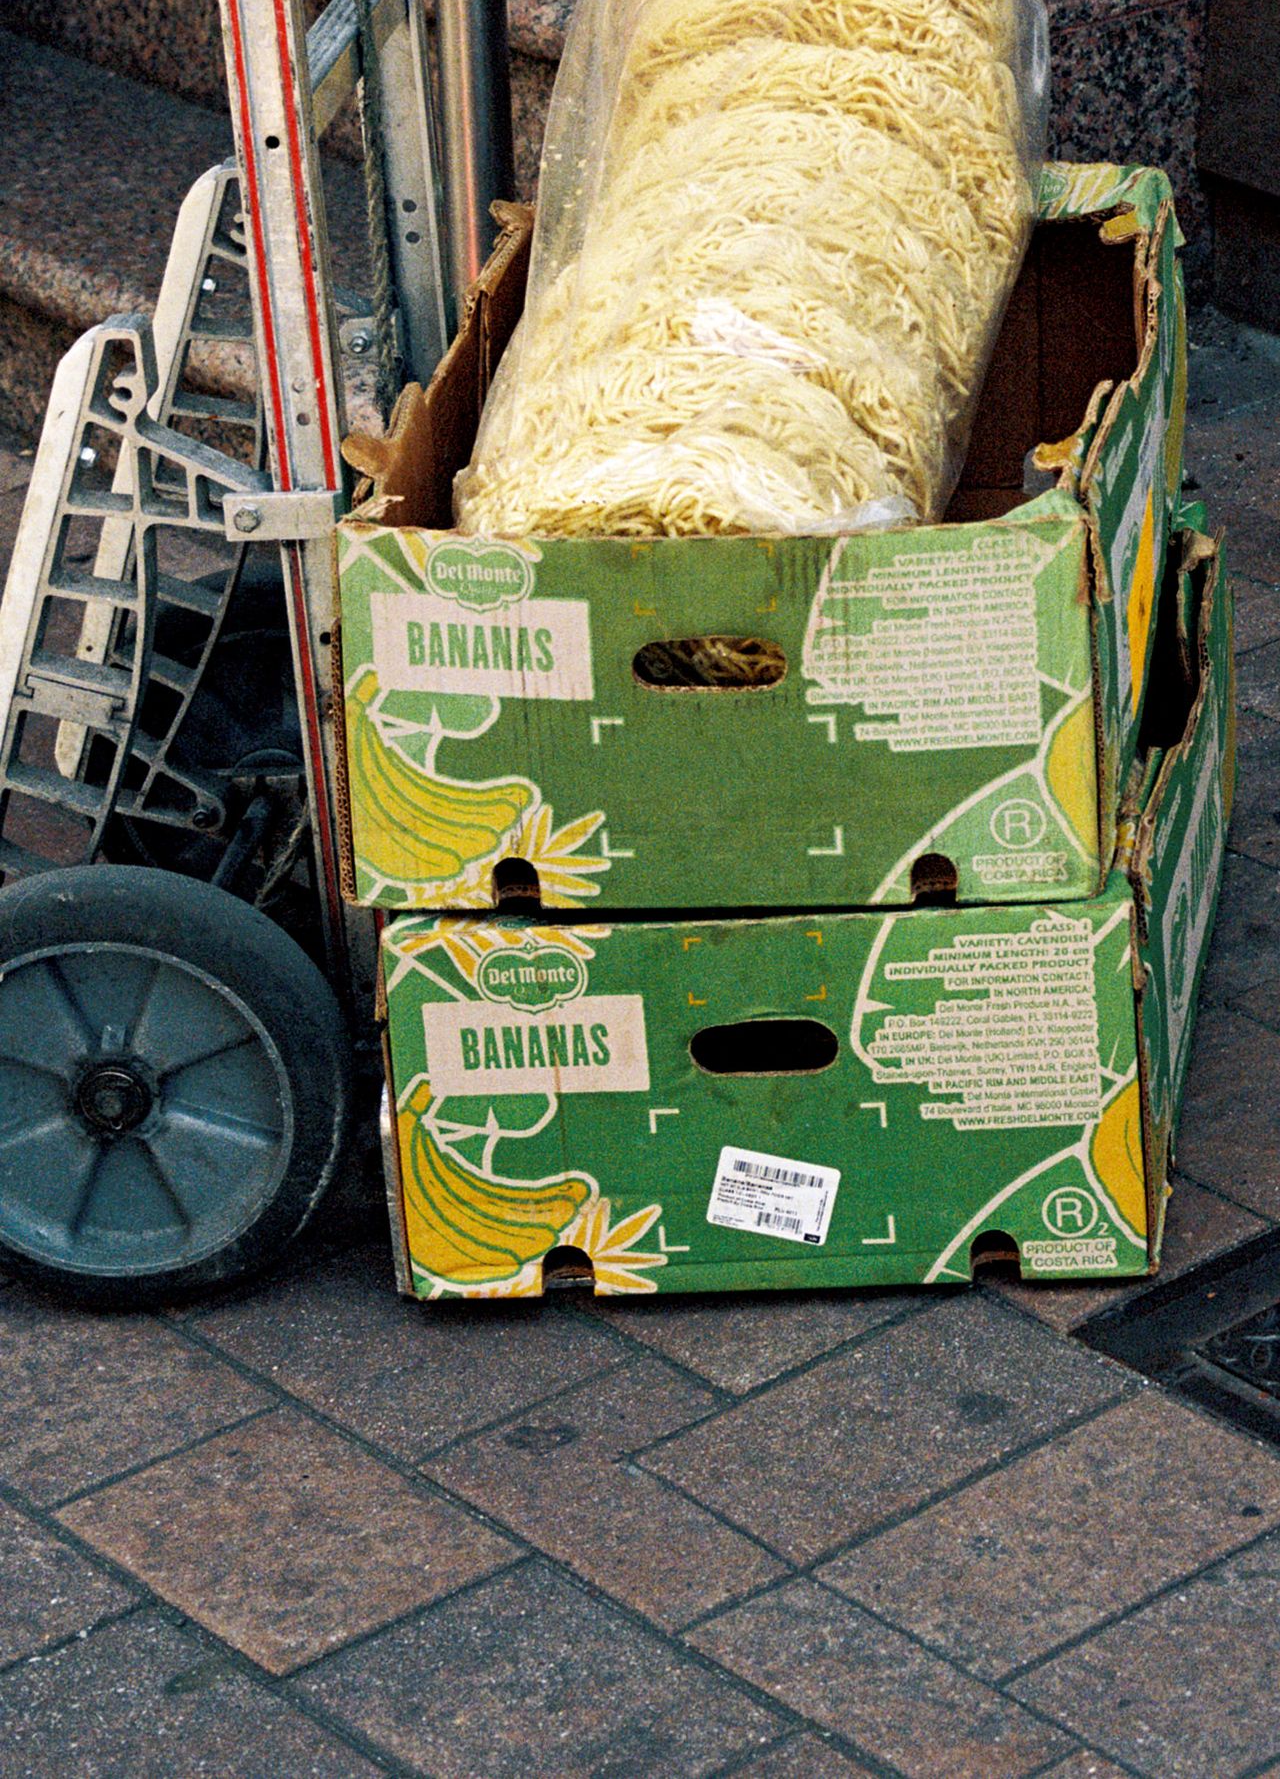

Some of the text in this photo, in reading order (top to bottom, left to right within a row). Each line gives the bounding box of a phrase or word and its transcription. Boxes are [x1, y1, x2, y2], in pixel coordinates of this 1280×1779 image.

[434, 561, 522, 584] Del Monte
[406, 621, 556, 673] BANANAS
[976, 854, 1041, 868] PRODUCT
[958, 934, 1088, 948] VARIETY: CAVENDISH
[933, 947, 1090, 961] MINIMUM LENGTH: 20 cm
[889, 958, 1089, 976] INDIVIDUALLY PACKED PRODUCT
[487, 966, 576, 985] Del Monte
[948, 977, 969, 987] FOR
[971, 974, 1040, 986] INFORMATION
[993, 984, 1091, 998] IN NORTH AMERICA:
[892, 1030, 935, 1041] EUROPE:
[459, 1022, 612, 1071] BANANAS
[945, 1078, 984, 1089] PACIFIC
[986, 1077, 1004, 1087] RIM
[1006, 1076, 1027, 1086] AND
[1029, 1074, 1066, 1085] MIDDLE
[958, 1111, 1100, 1126] WWW.FRESHDELMONTE.COM
[1097, 1221, 1110, 1236] 2
[1026, 1240, 1113, 1254] PRODUCT OF
[1034, 1254, 1114, 1268] COSTA RICA
